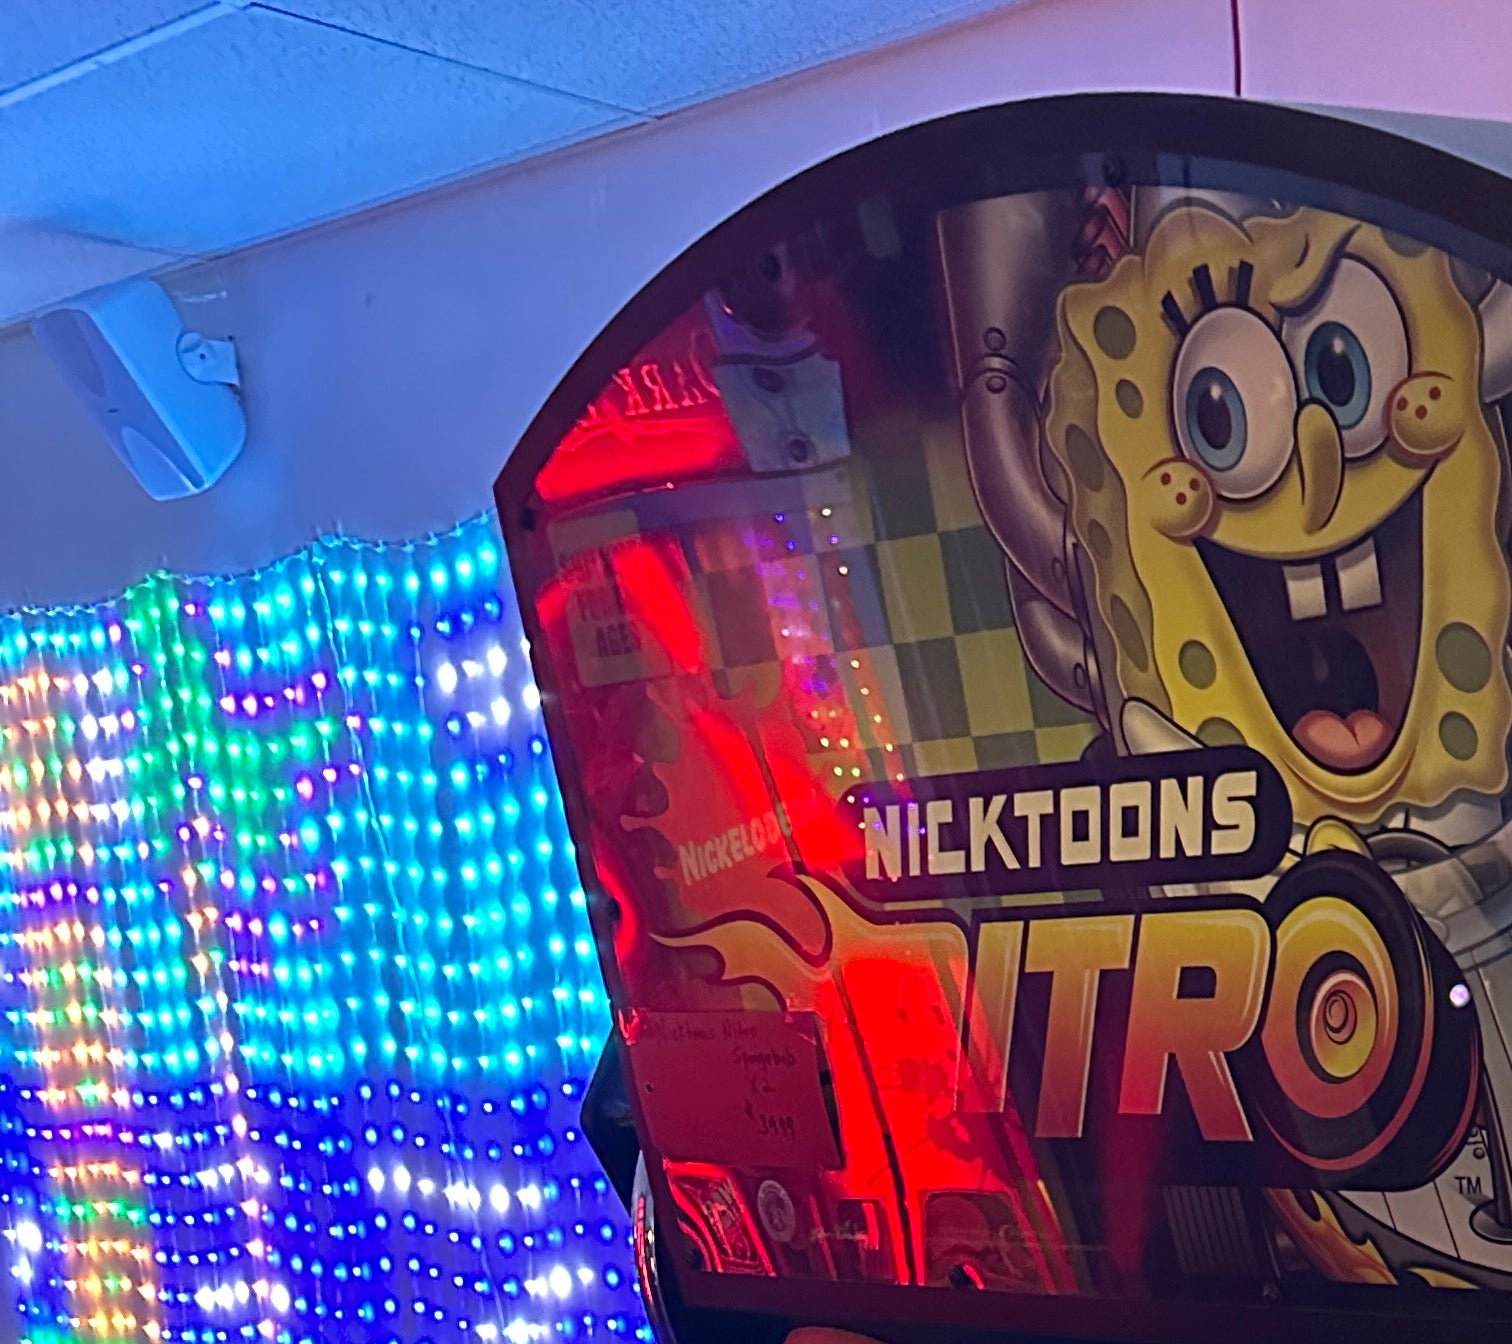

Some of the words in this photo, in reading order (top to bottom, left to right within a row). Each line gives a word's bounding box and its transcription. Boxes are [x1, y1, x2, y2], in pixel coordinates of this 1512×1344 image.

[678, 810, 792, 887] NICKELOD
[863, 772, 1259, 881] NICKTOONS
[1454, 1176, 1482, 1195] TM
